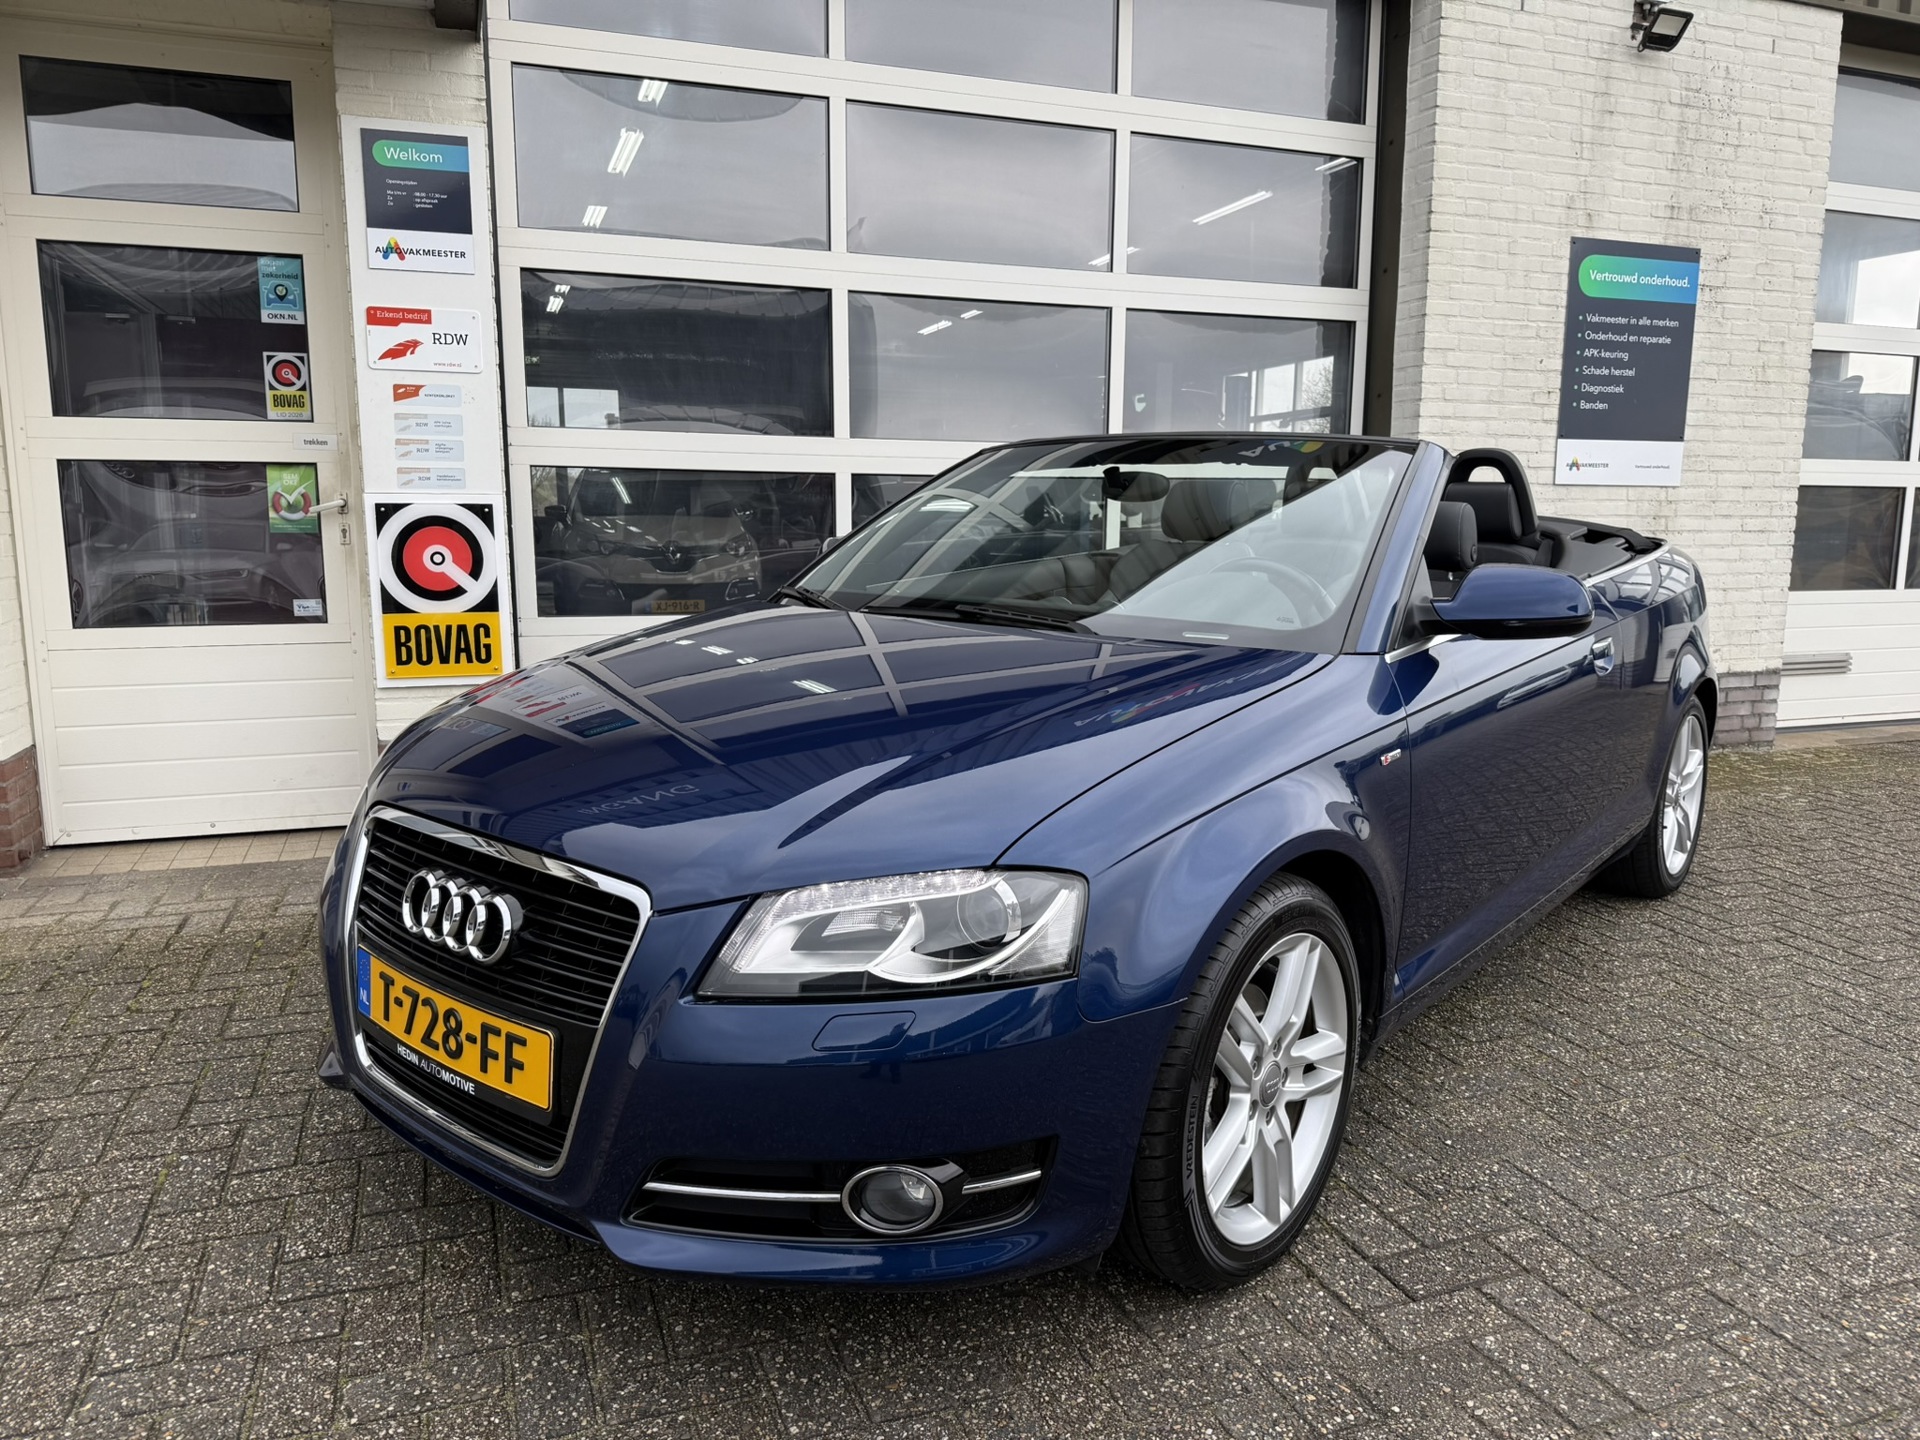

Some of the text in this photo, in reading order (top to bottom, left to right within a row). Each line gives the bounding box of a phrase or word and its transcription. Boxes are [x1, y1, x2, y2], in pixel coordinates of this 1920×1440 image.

[383, 146, 443, 163] Welkom
[374, 246, 466, 259] AUTOVAKMEESTER
[261, 271, 299, 280] zekerheid
[1589, 269, 1691, 288] Vertrouwd onderhoud.
[267, 312, 298, 321] OKN.NL
[376, 310, 428, 322] Erkend bedrijf
[1586, 313, 1679, 328] Vakmeester in alle merken
[431, 332, 469, 346] RDW
[1585, 330, 1628, 343] Onderhoud
[1639, 335, 1672, 346] reparatie
[1583, 348, 1629, 361] APK-keuring
[1582, 365, 1636, 378] Schade herstel
[1581, 383, 1625, 395] Diagnostiek
[272, 394, 305, 408] BOVAG
[1579, 400, 1608, 411] Banden
[303, 438, 329, 447] trekken
[655, 601, 701, 612] XJ-916-R
[393, 623, 493, 666] BOVAG
[359, 987, 370, 1005] NL
[378, 970, 528, 1085] T-728-FF
[396, 1043, 476, 1095] HEDIN AUTOMOTIVE
[1185, 1095, 1199, 1180] VREDESTEIN
